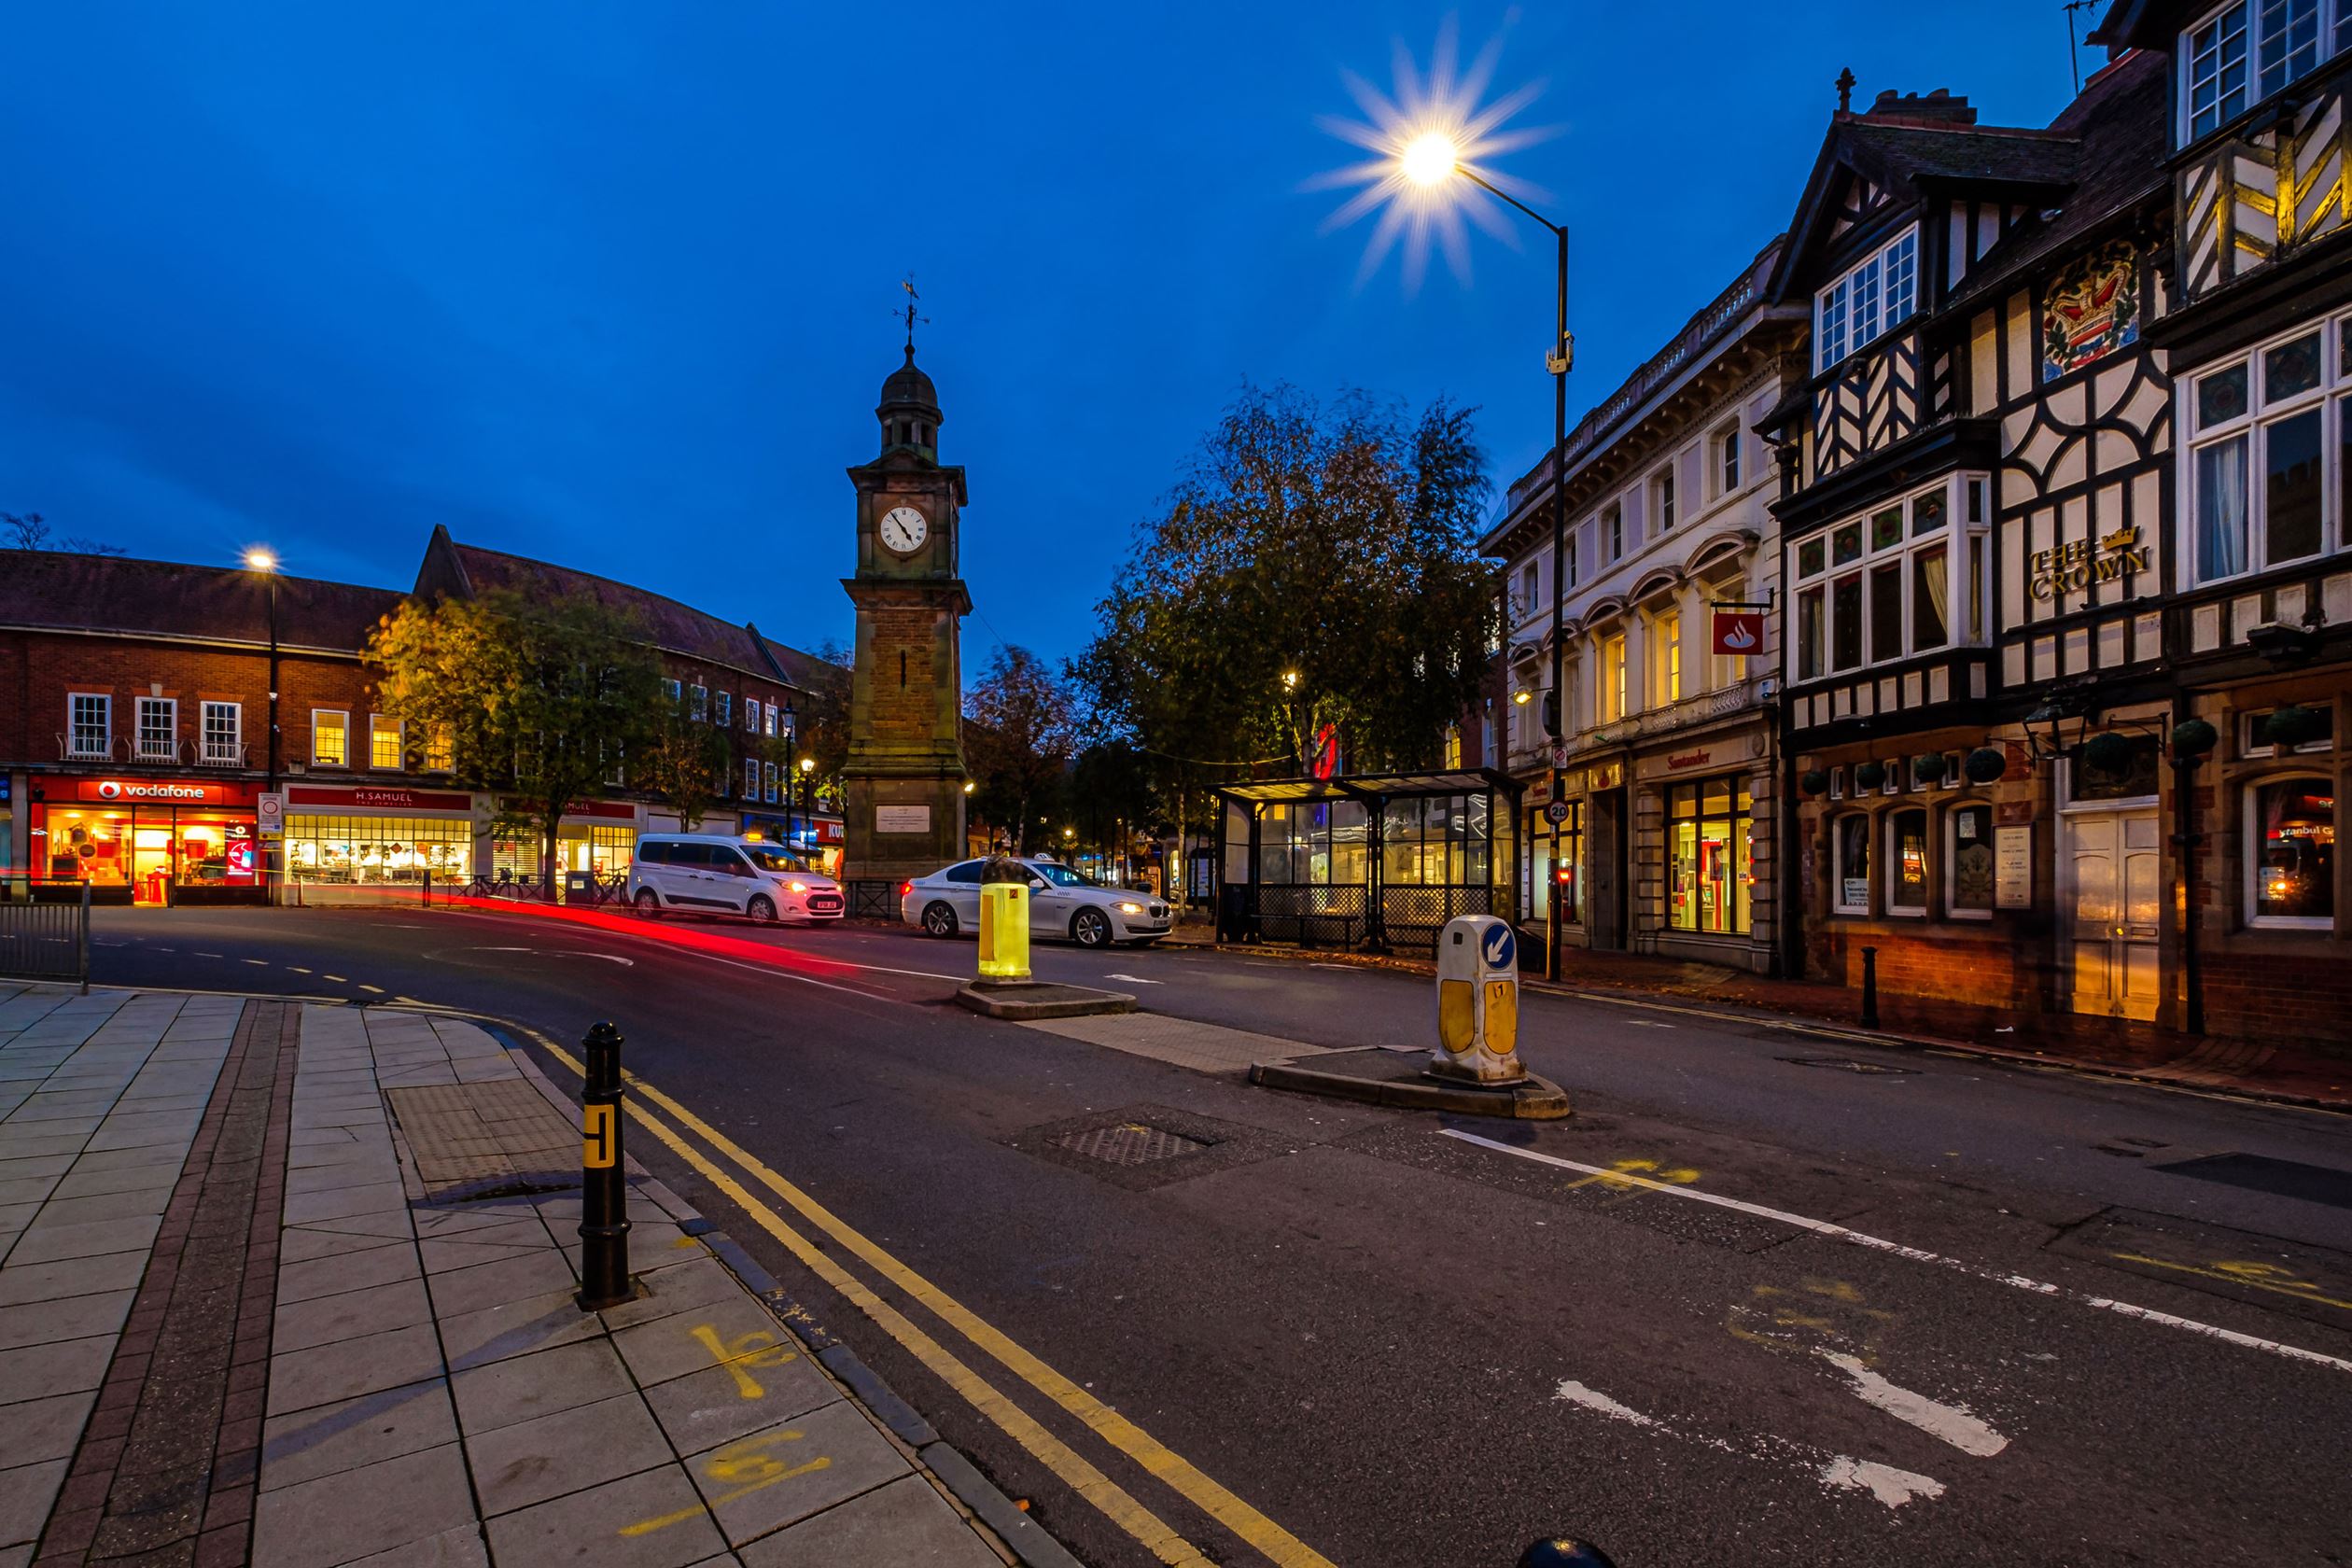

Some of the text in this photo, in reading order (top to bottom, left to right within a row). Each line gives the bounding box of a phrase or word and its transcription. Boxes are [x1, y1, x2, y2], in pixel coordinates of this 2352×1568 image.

[2030, 538, 2091, 573] THE
[2029, 546, 2149, 600] CROWN
[1667, 749, 1711, 770] Santander
[125, 784, 204, 798] vodafone
[356, 791, 413, 802] H.SAMUEL
[1551, 806, 1567, 817] 20
